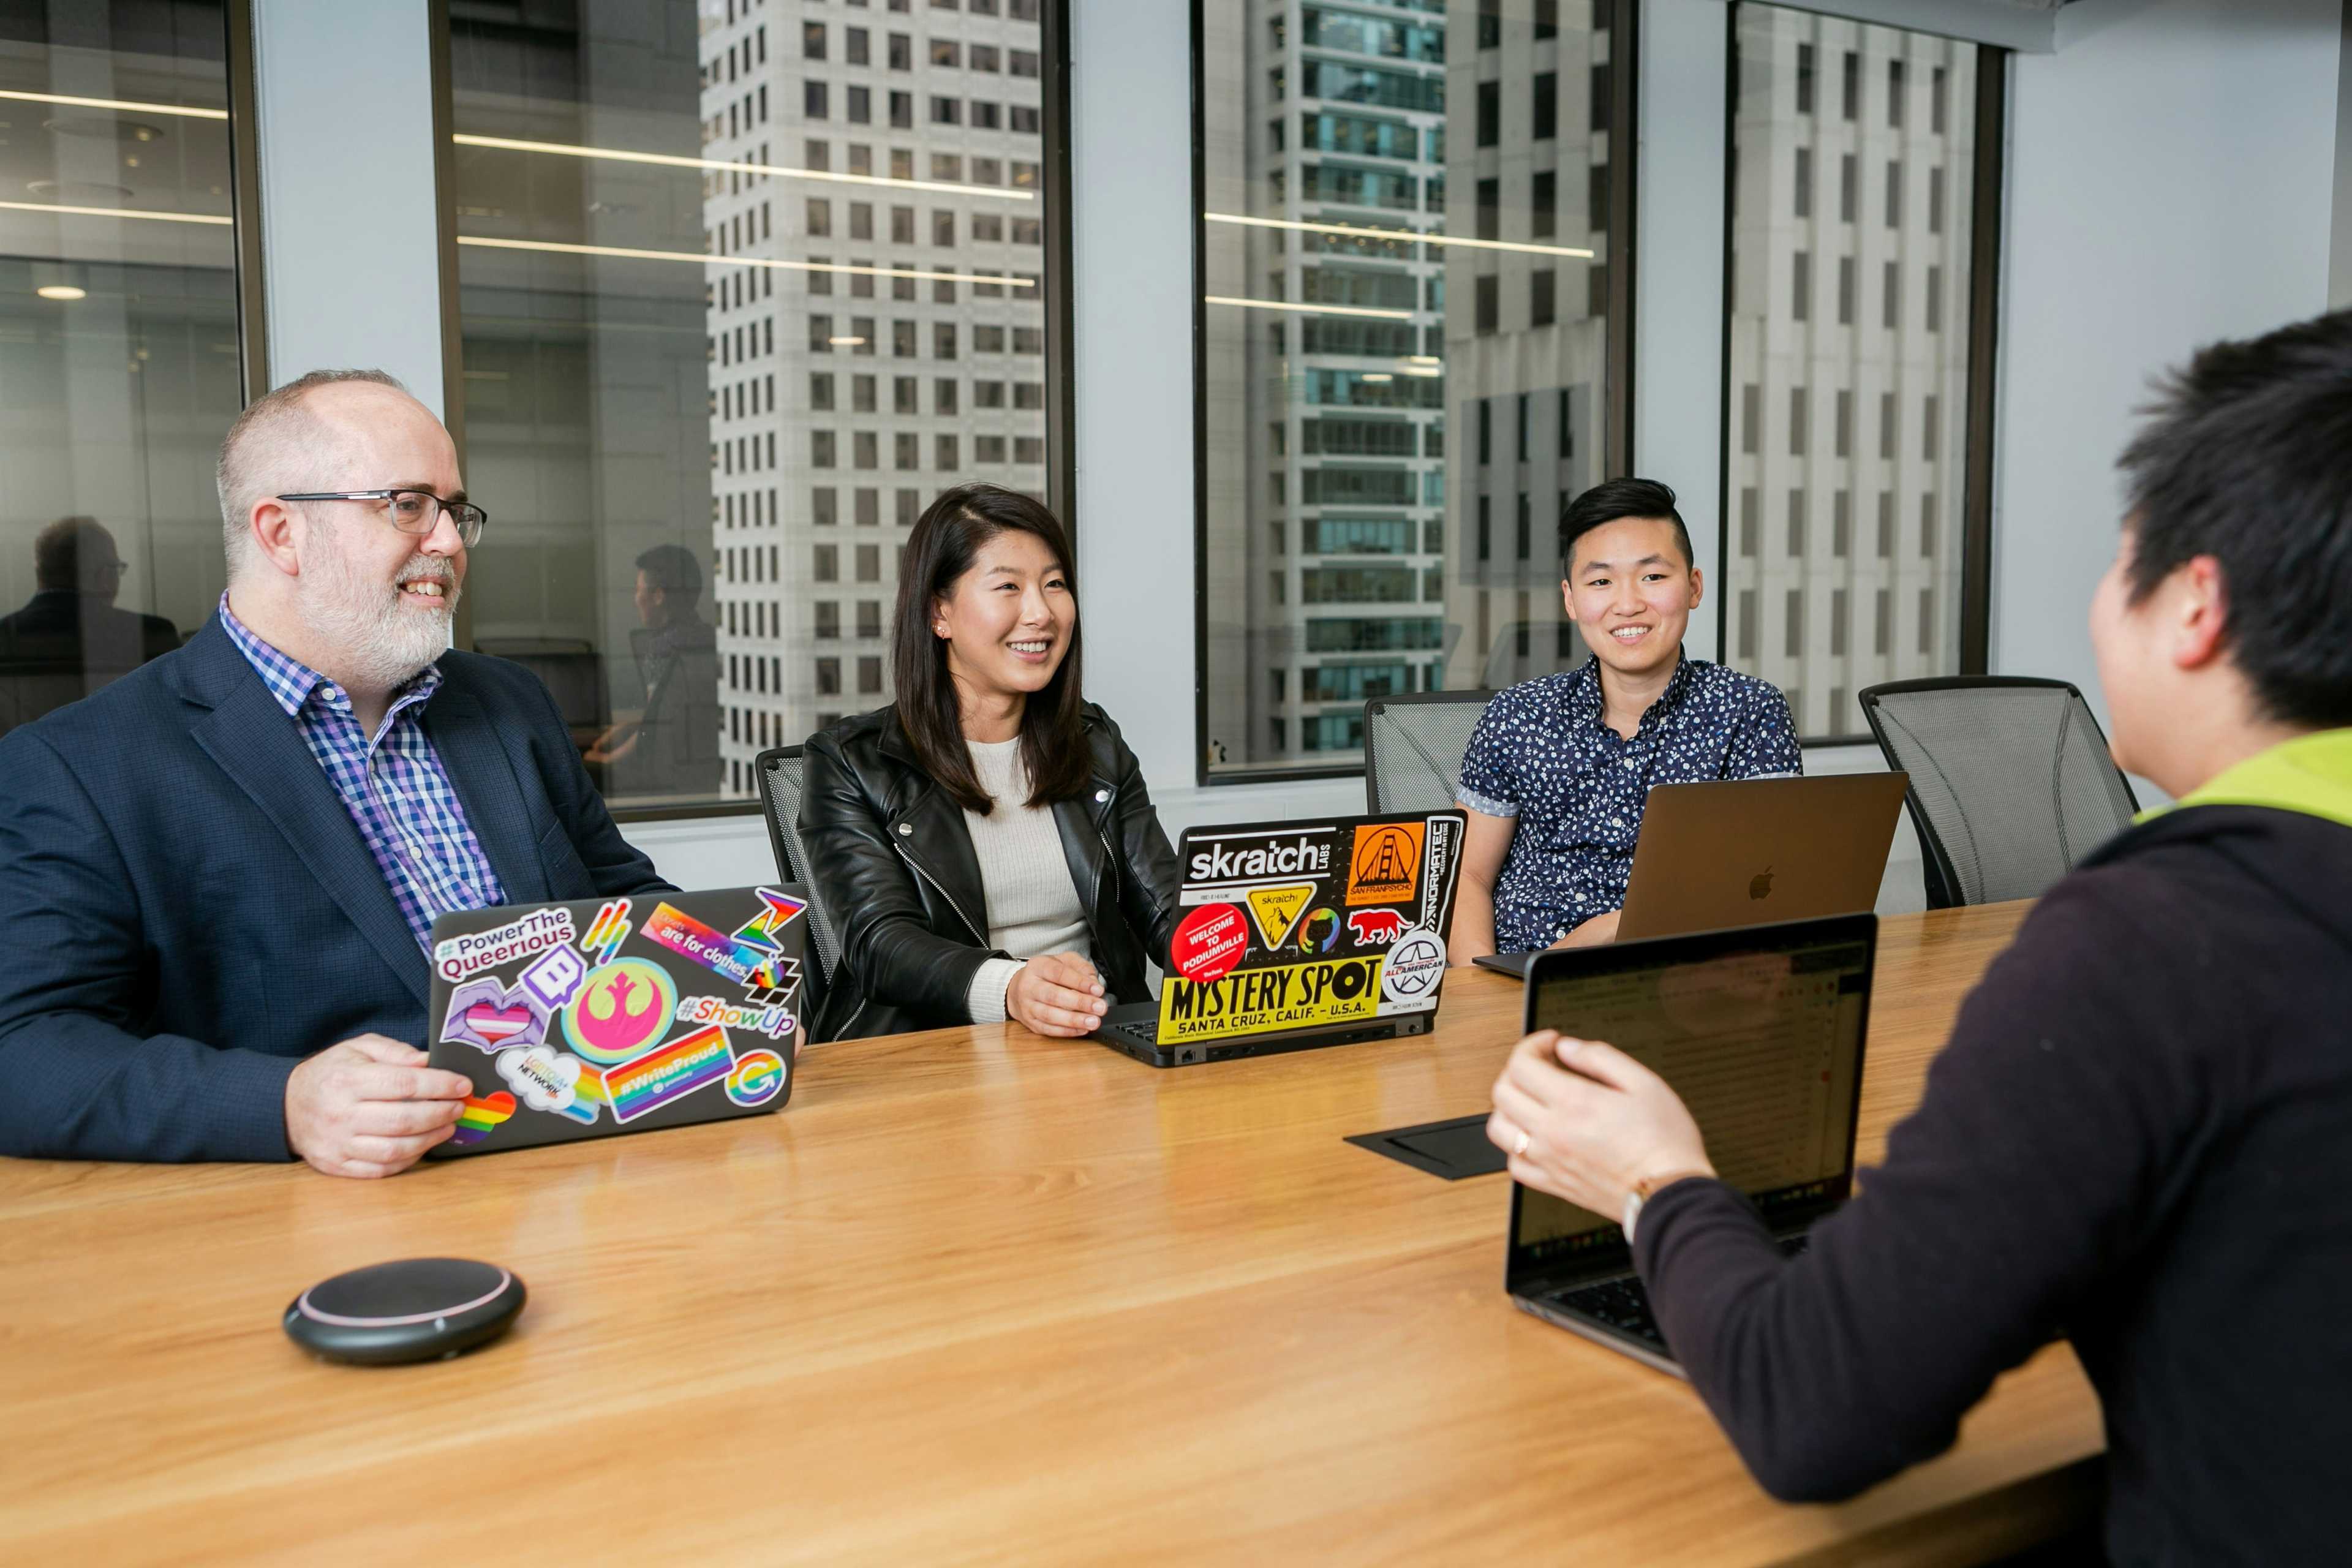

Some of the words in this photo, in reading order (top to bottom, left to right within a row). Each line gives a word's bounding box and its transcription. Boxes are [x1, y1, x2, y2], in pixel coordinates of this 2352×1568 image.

[1189, 837, 1319, 880] skratch
[1318, 844, 1330, 869] LABS
[1428, 823, 1443, 909] NORMATEC
[1189, 916, 1235, 945] WELCOME
[1206, 935, 1219, 948] TO
[443, 927, 571, 978] Queerious
[661, 925, 684, 944] are
[683, 935, 705, 954] for
[703, 947, 748, 978] clothes.
[1183, 932, 1245, 971] PODIUMVILLE
[1401, 960, 1444, 973] AMERICAN
[1170, 968, 1295, 1021] MYSTERY
[1296, 959, 1382, 1006] SPOT
[680, 1000, 794, 1035] #ShowUp
[1178, 1019, 1225, 1034] SANTA
[1231, 1013, 1271, 1027] CRUZ,
[1276, 1008, 1315, 1022] CALIF.
[1330, 1002, 1365, 1015] U.S.A.
[518, 1064, 561, 1094] NETWORK
[620, 1042, 720, 1096] #WriteProud
